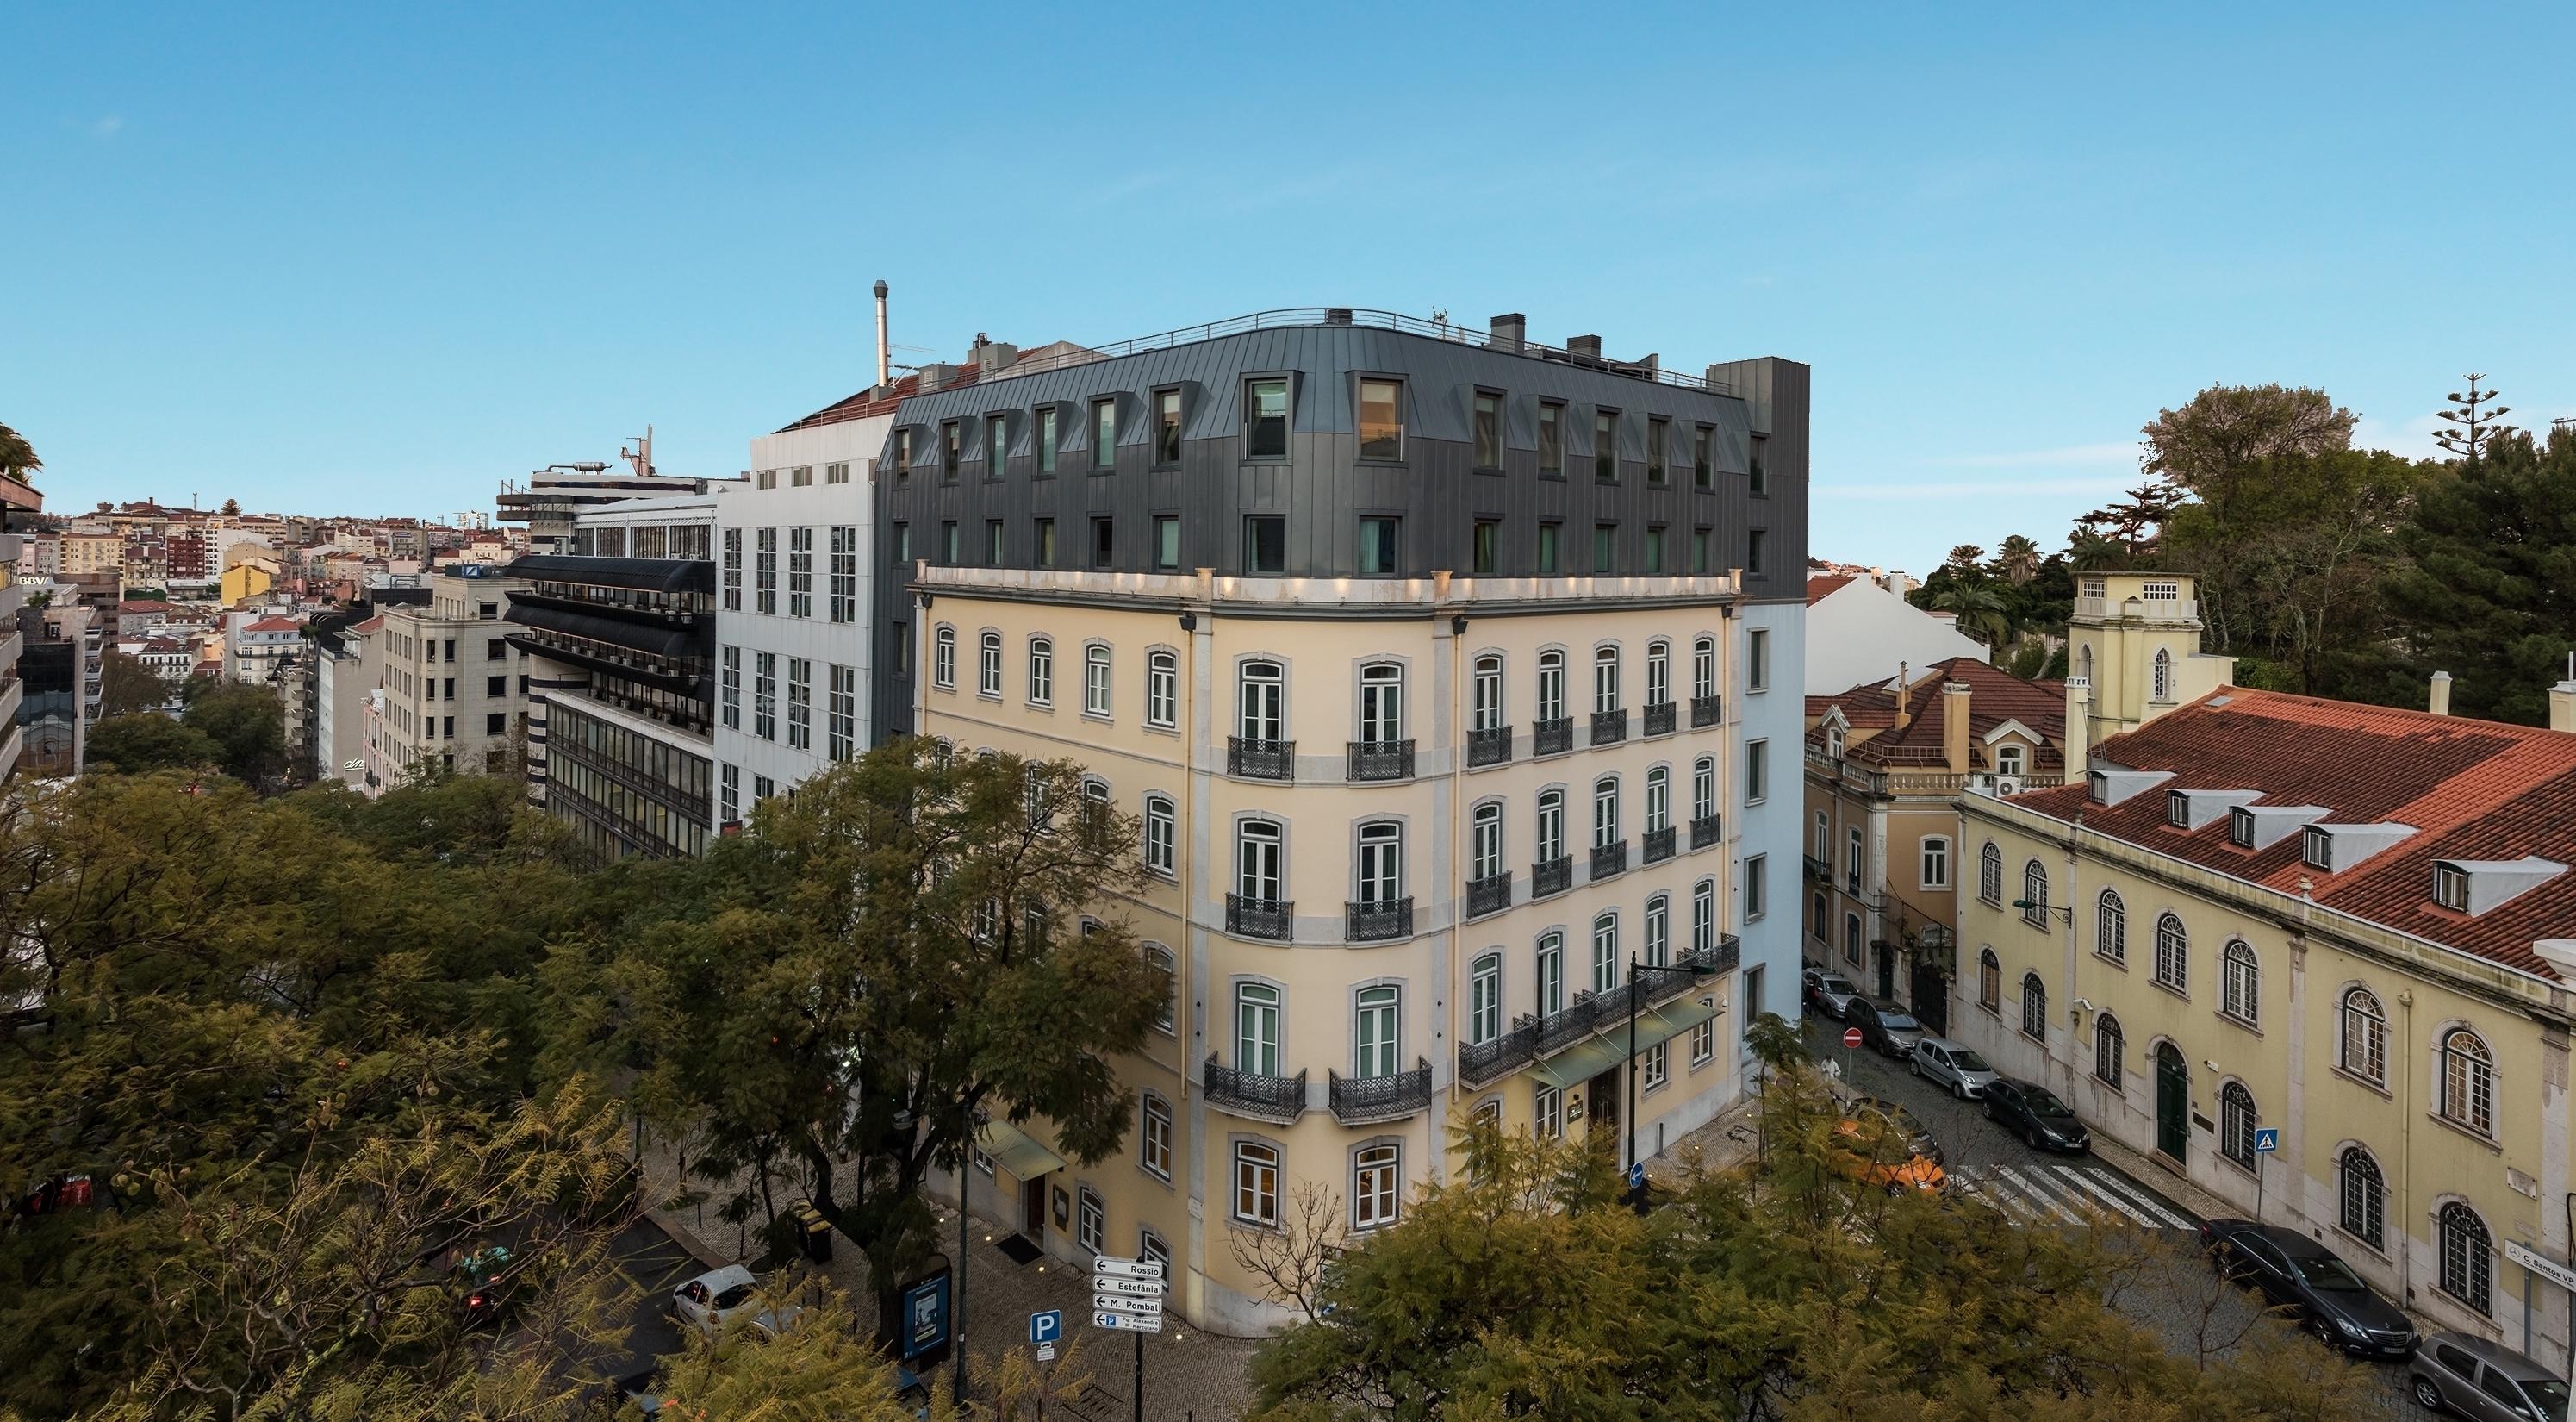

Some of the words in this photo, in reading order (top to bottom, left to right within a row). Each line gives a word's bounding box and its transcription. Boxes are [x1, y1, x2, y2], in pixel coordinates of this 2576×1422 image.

[1131, 1266, 1159, 1275] Rossio
[2534, 1259, 2560, 1277] Santos
[2562, 1274, 2574, 1283] VP
[1118, 1282, 1159, 1294] Estefânia
[1111, 1300, 1120, 1308] M.
[1126, 1300, 1158, 1312] Pombal
[1037, 1315, 1055, 1340] P
